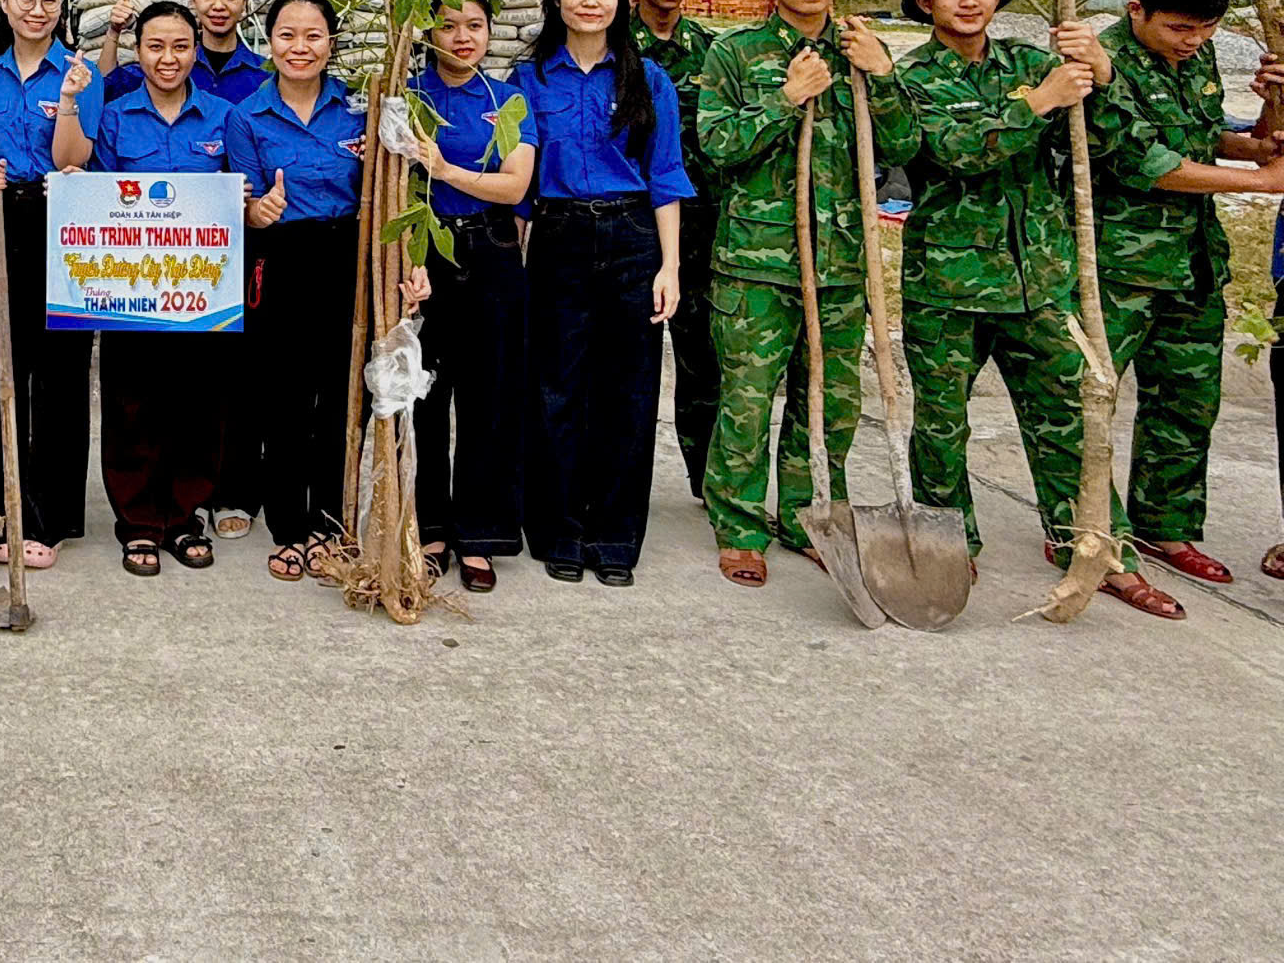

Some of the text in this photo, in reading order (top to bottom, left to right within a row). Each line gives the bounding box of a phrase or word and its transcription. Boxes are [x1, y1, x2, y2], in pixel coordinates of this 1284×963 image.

[109, 211, 182, 220] ĐOÀN XÃ TÂN HIỆP
[60, 222, 230, 247] CÔNG TRÌNH THANH NIÊN
[84, 290, 207, 313] THANH NIÊN 2026
